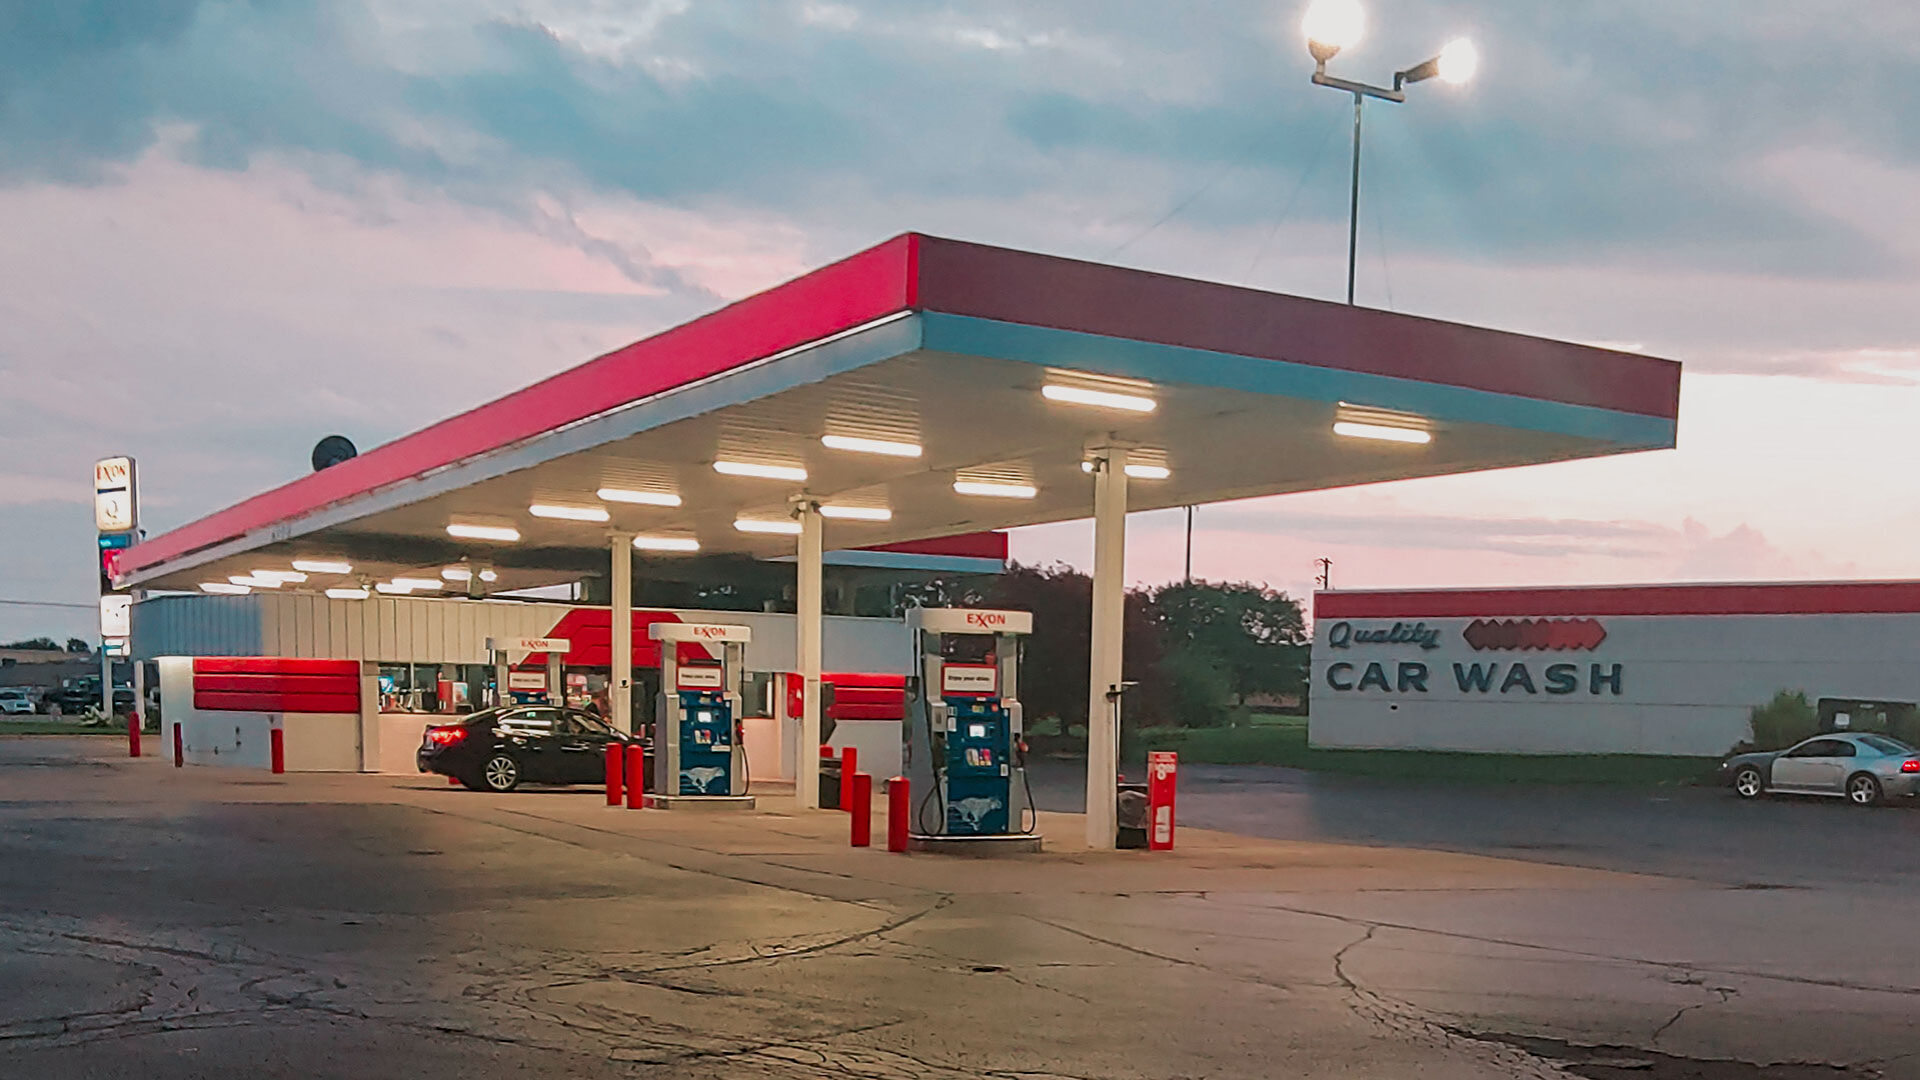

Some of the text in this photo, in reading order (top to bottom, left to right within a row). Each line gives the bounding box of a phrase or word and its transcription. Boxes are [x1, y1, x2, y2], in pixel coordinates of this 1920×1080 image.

[966, 613, 1006, 628] EXXON
[693, 626, 727, 639] EXXON
[1329, 621, 1440, 649] Quality
[521, 640, 549, 650] EXXON
[1326, 662, 1624, 695] CAR WASH
